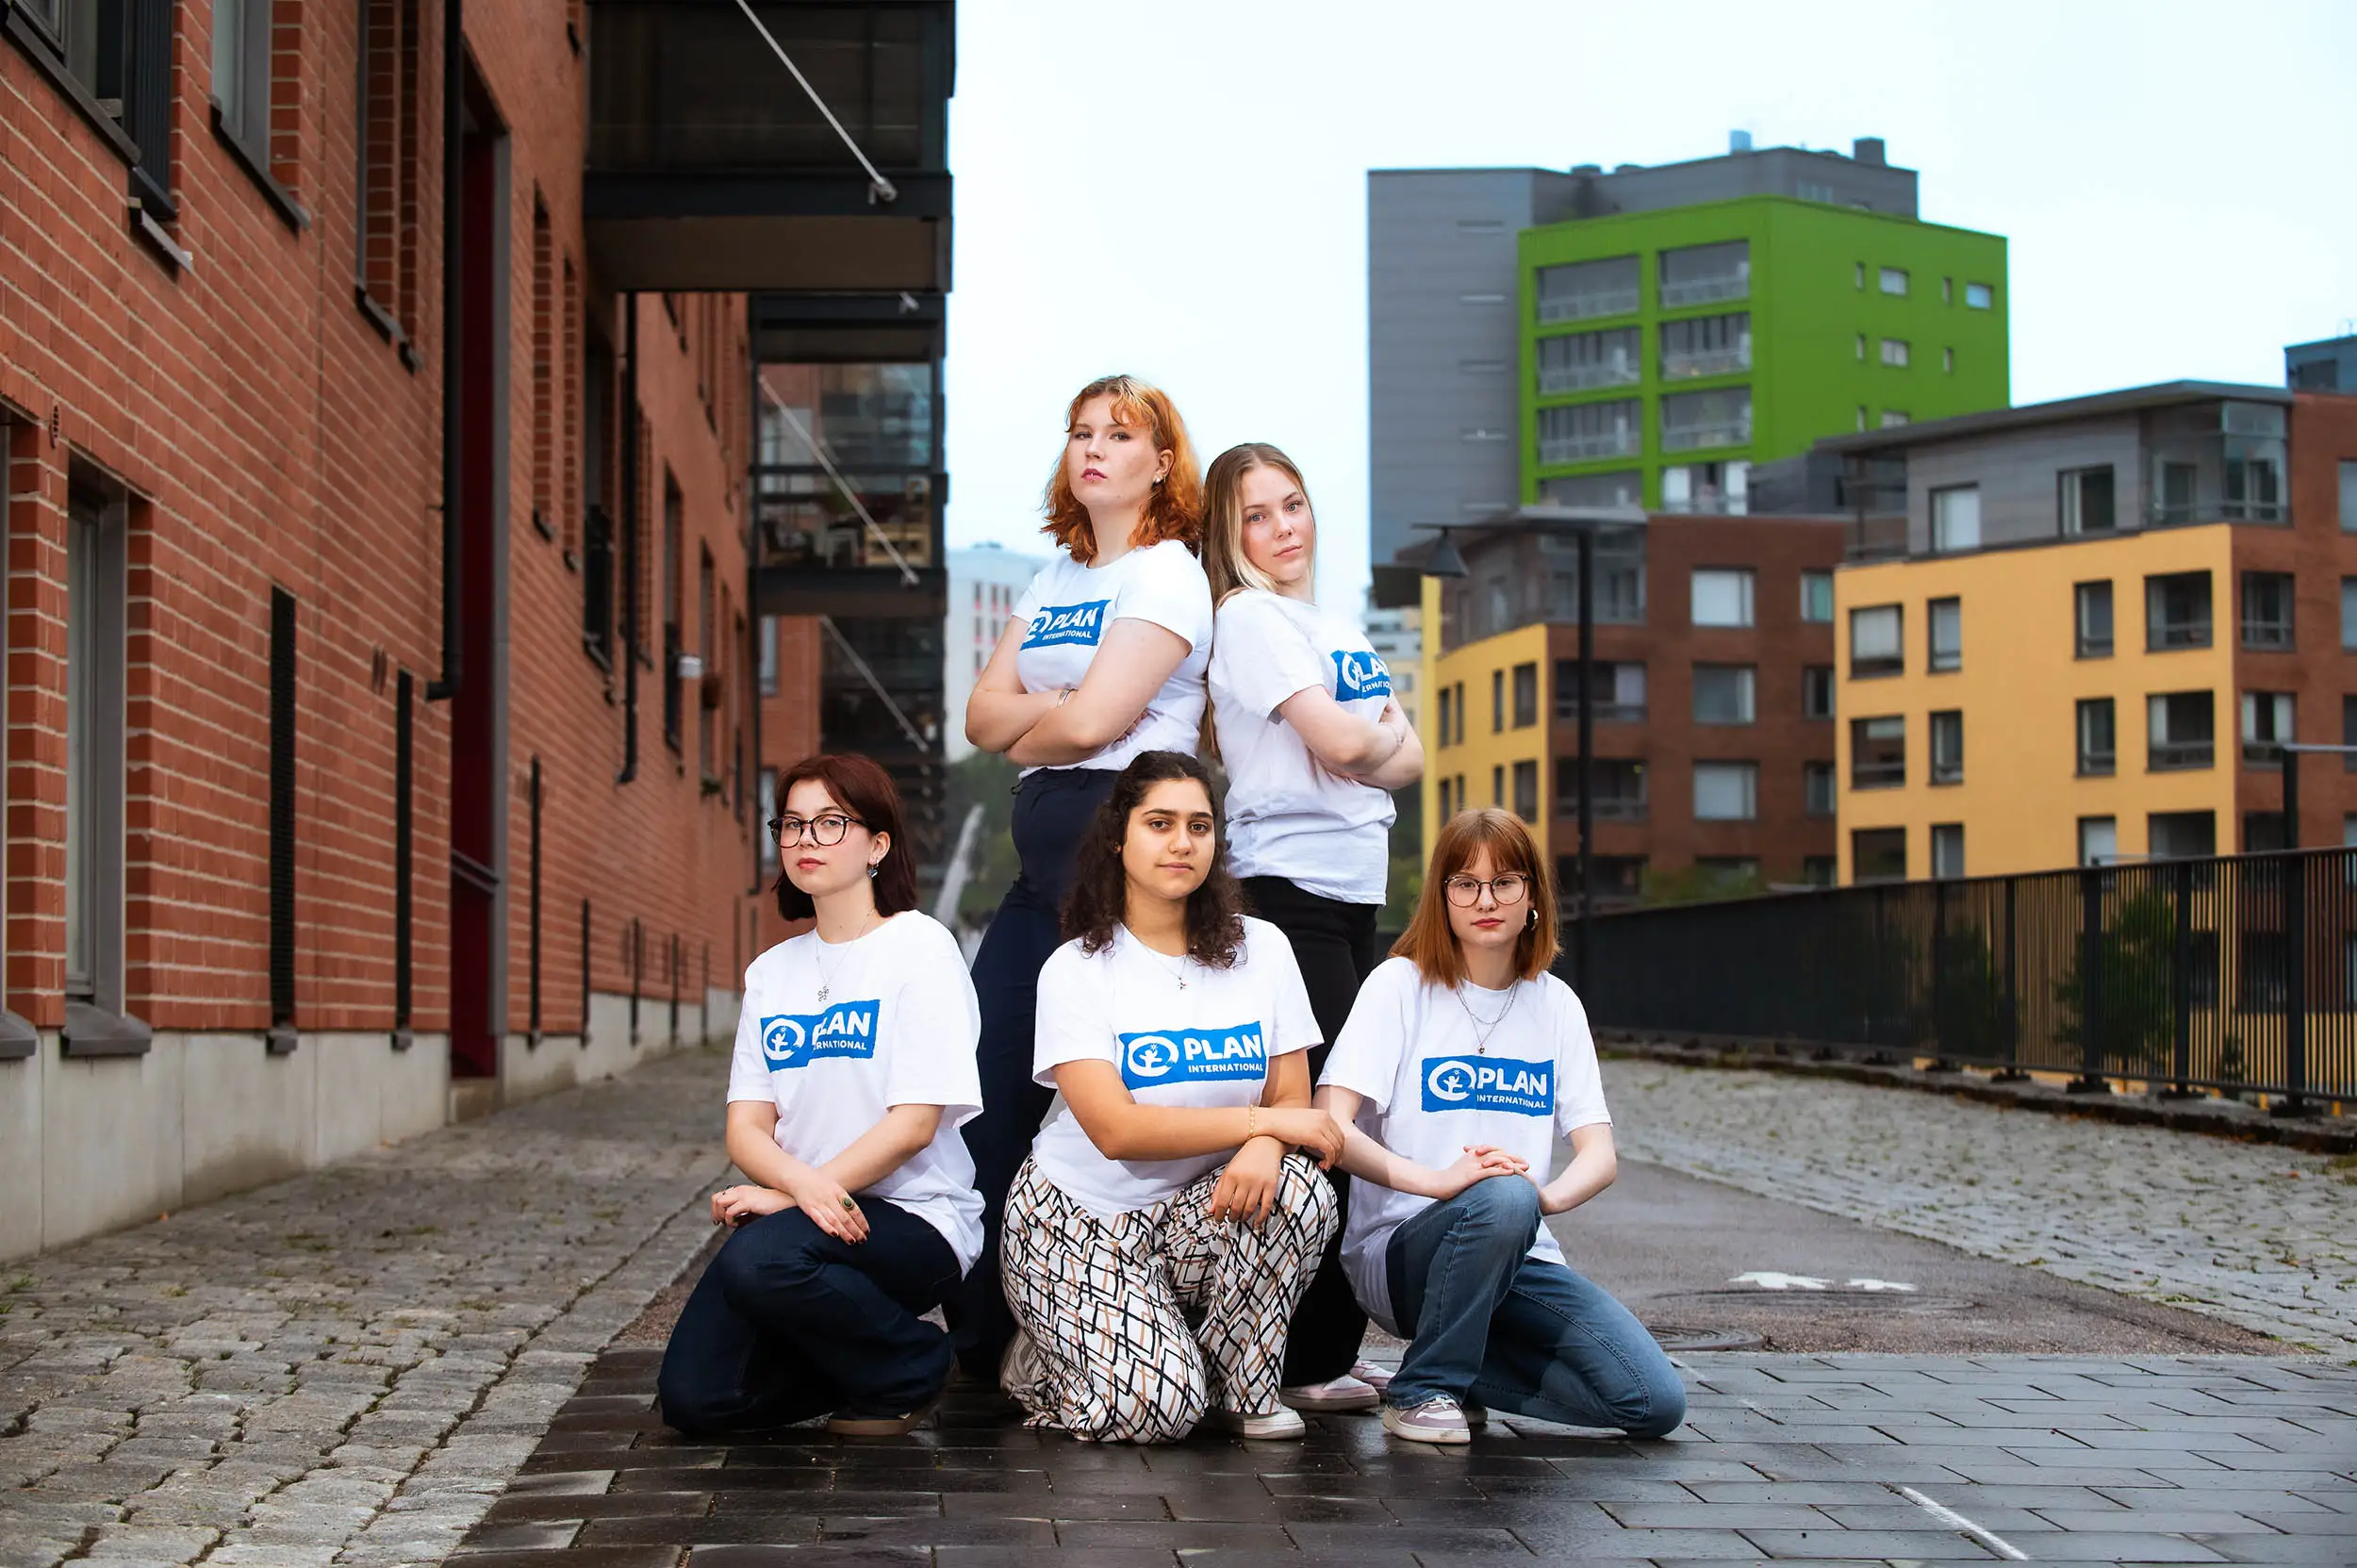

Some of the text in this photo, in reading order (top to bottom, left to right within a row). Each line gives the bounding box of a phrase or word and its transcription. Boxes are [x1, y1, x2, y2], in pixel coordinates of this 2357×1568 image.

[1048, 607, 1099, 631] PLAN
[1042, 630, 1092, 640] INTERNATIONAL
[1183, 1034, 1261, 1061] PLAN
[1188, 1063, 1263, 1073] INTERNATIONAL
[1476, 1066, 1547, 1096] PLAN
[1476, 1094, 1547, 1109] INTERNATIONAL
